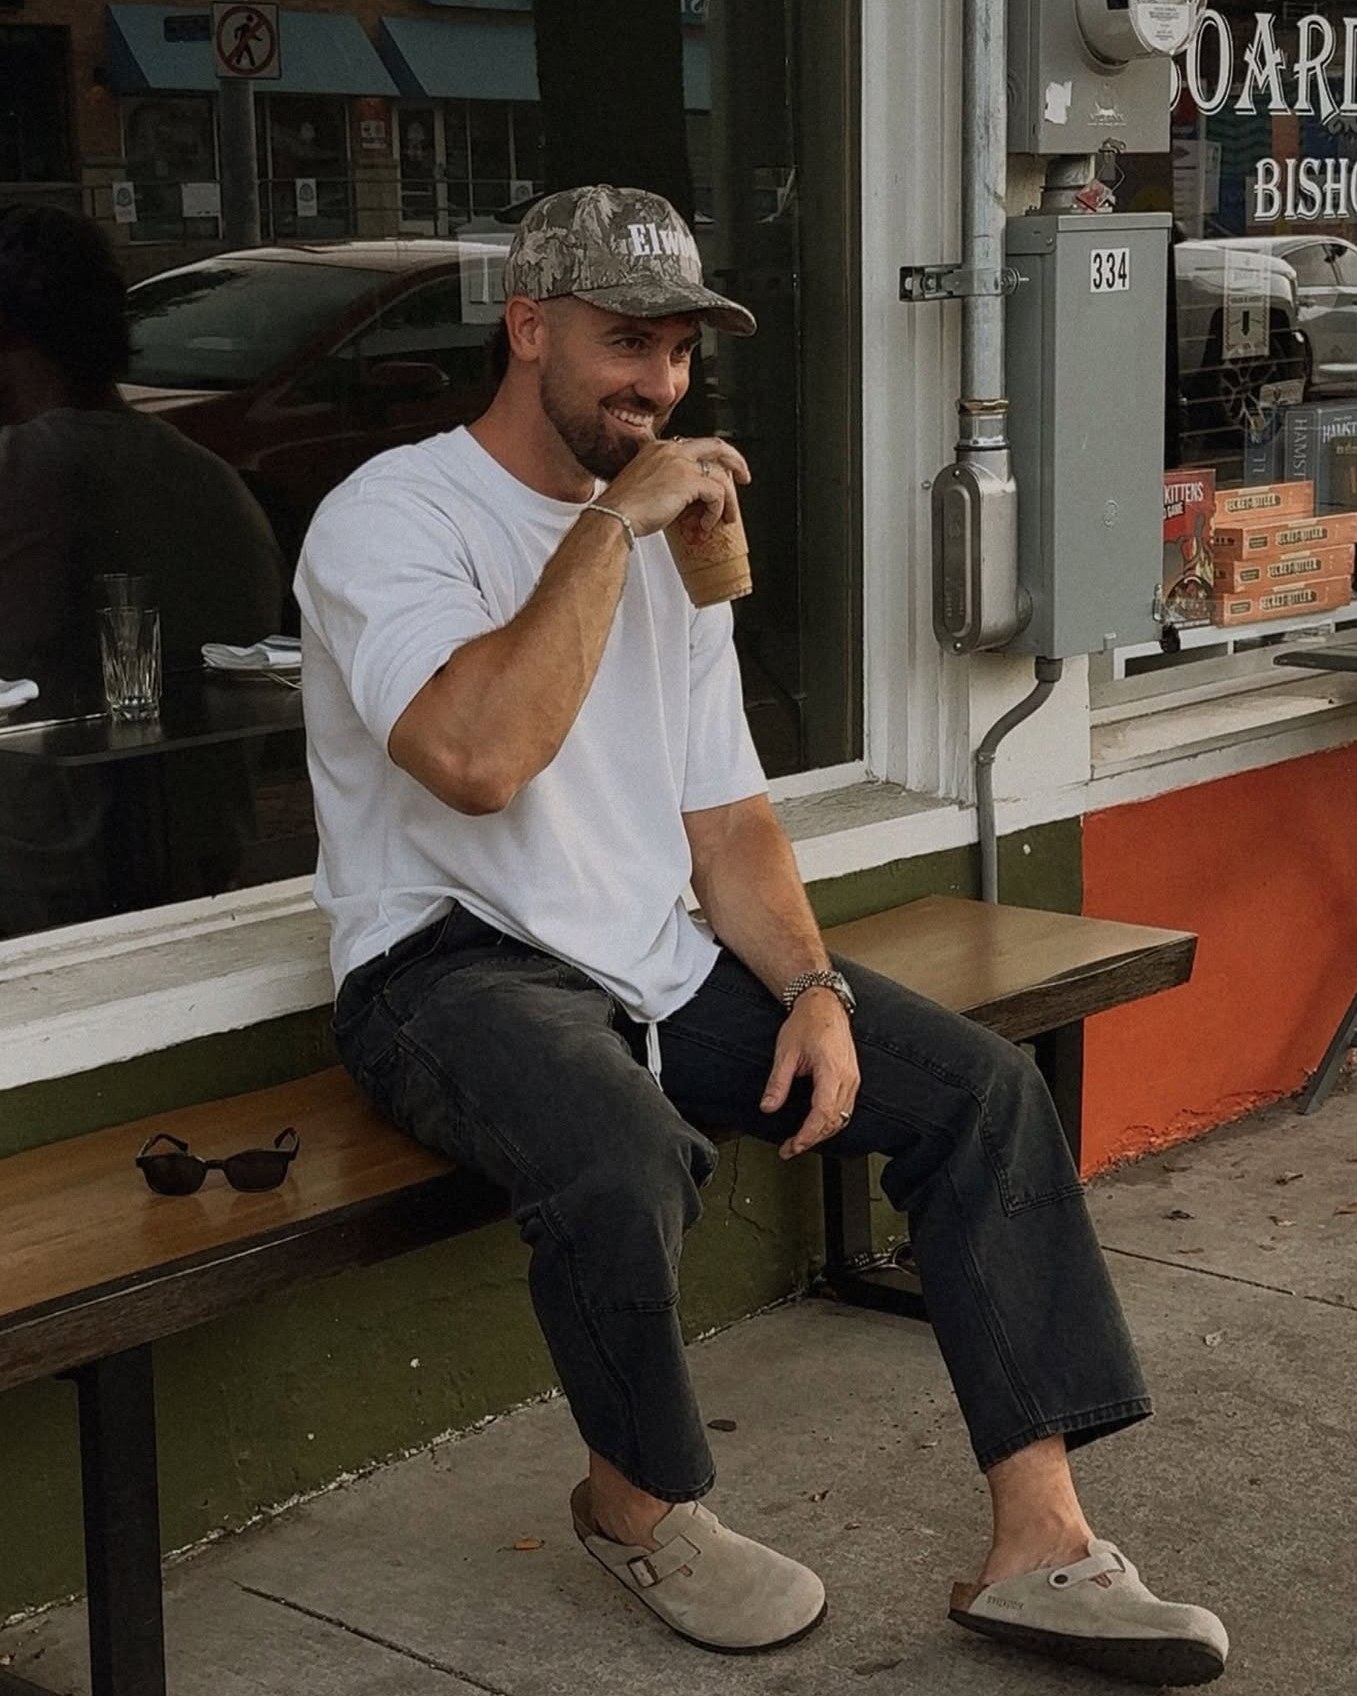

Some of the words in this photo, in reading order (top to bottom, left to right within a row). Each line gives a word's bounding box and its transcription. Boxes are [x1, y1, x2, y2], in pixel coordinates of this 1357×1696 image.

[1170, 8, 1357, 125] OAR
[1092, 251, 1128, 290] 334
[1163, 481, 1204, 505] KITTENS
